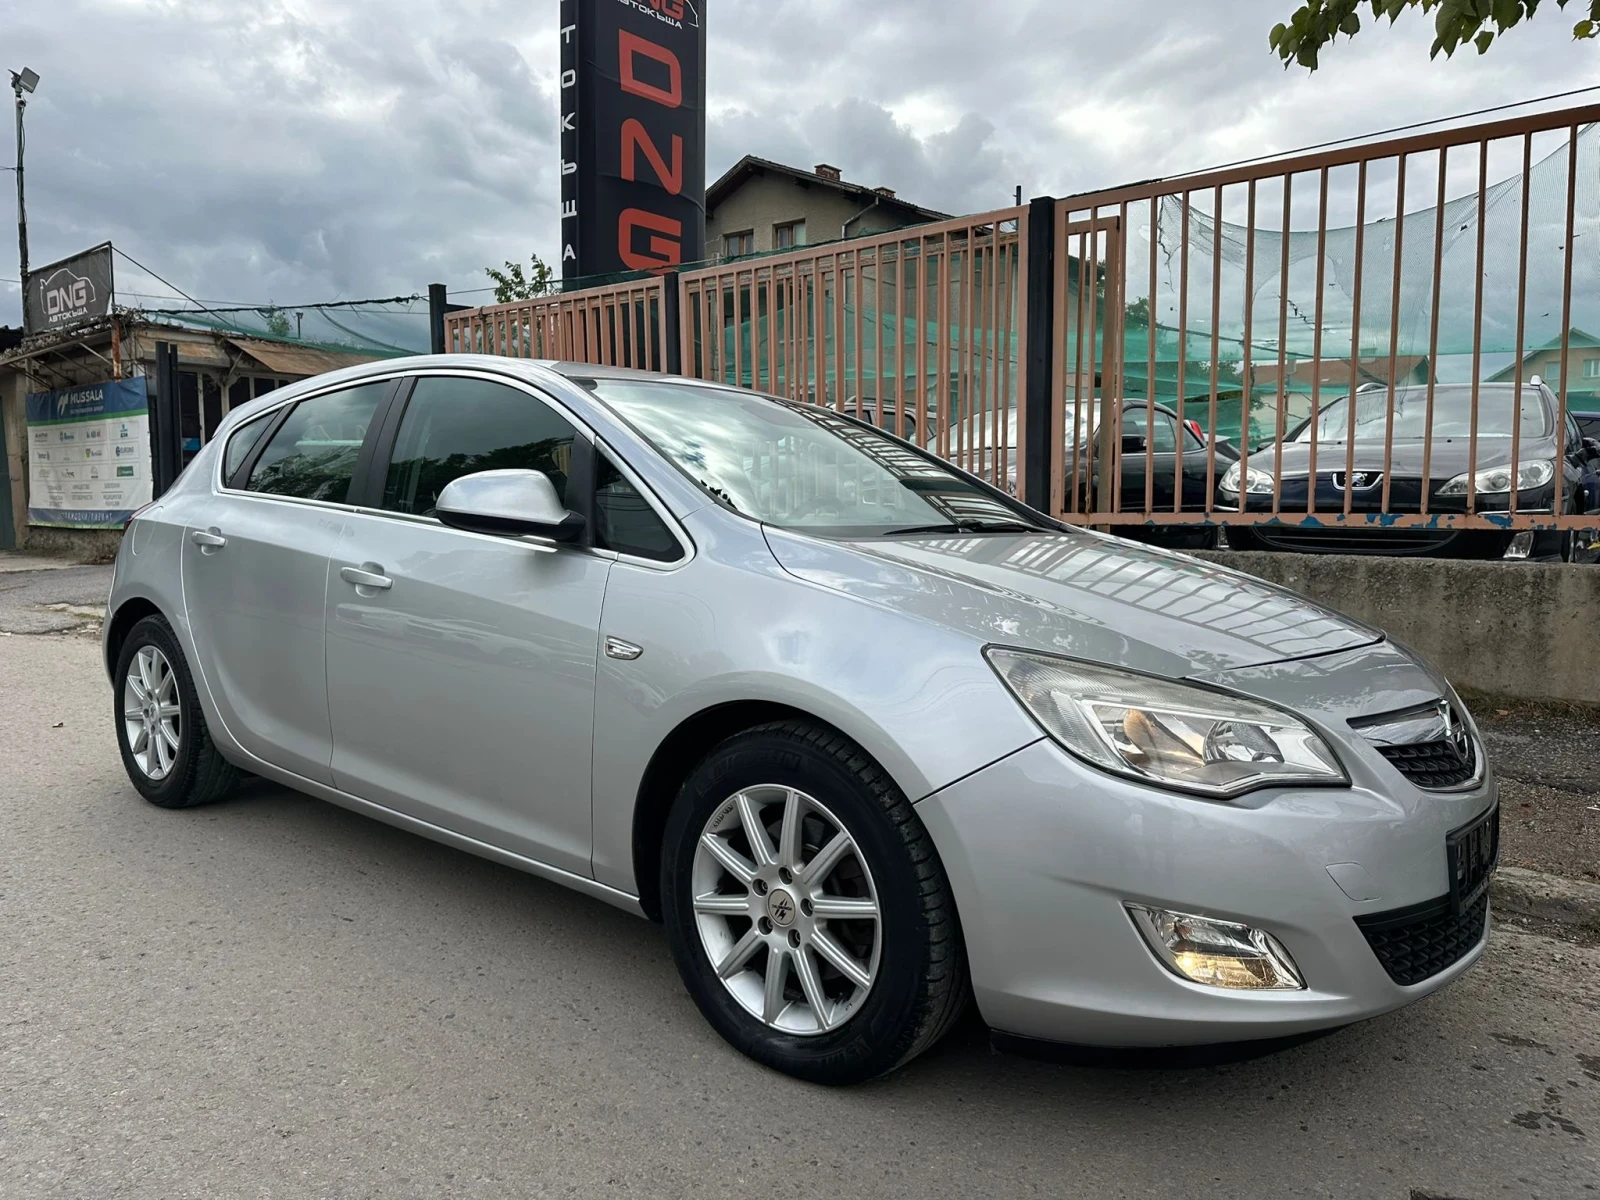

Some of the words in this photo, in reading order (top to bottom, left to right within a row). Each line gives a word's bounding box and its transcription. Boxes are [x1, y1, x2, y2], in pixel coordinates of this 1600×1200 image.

[618, 28, 683, 276] DNG
[46, 280, 87, 315] DNG
[70, 388, 104, 404] MUSSALA
